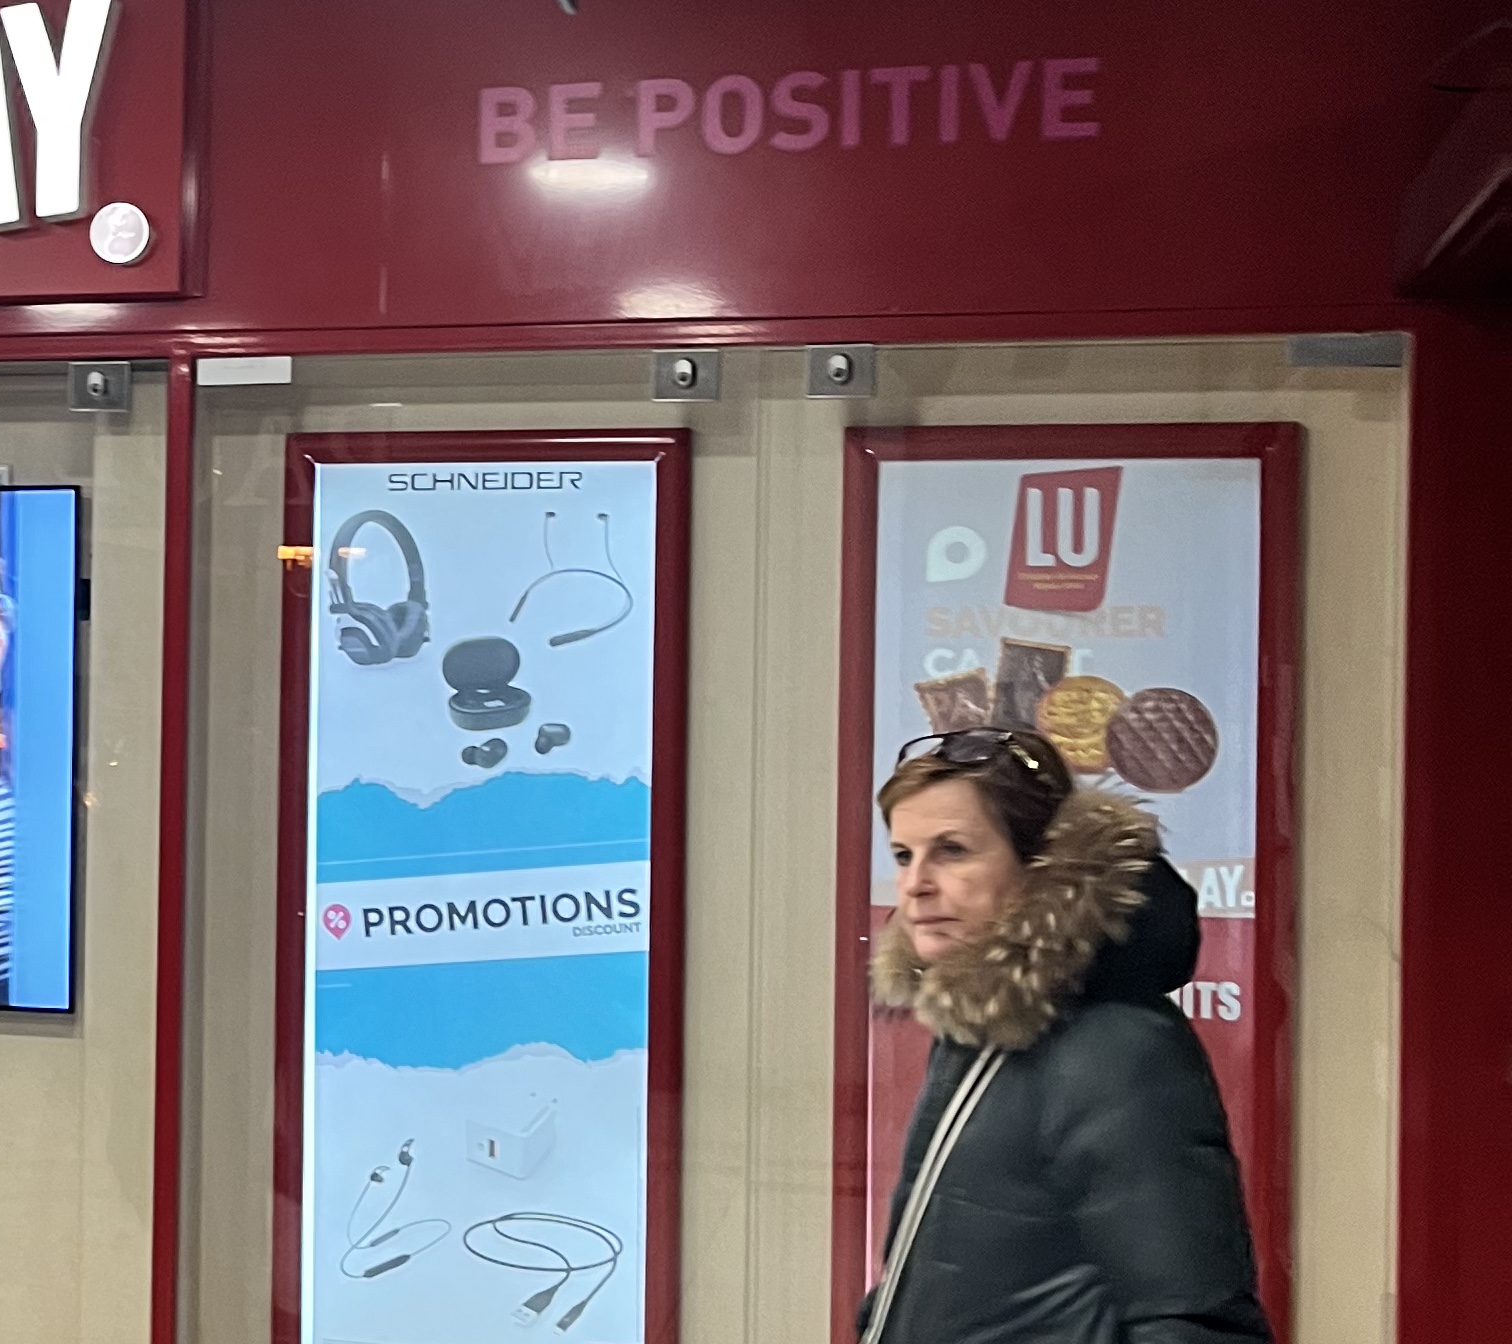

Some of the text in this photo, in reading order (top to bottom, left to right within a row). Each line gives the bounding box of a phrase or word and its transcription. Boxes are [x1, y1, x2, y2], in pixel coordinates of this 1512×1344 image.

[478, 56, 1102, 165] BE POSITIVE
[386, 470, 584, 493] SCHNEIDER
[1024, 487, 1101, 569] LU
[362, 887, 642, 939] PROMOTIONS
[572, 921, 642, 939] DISCOUNT
